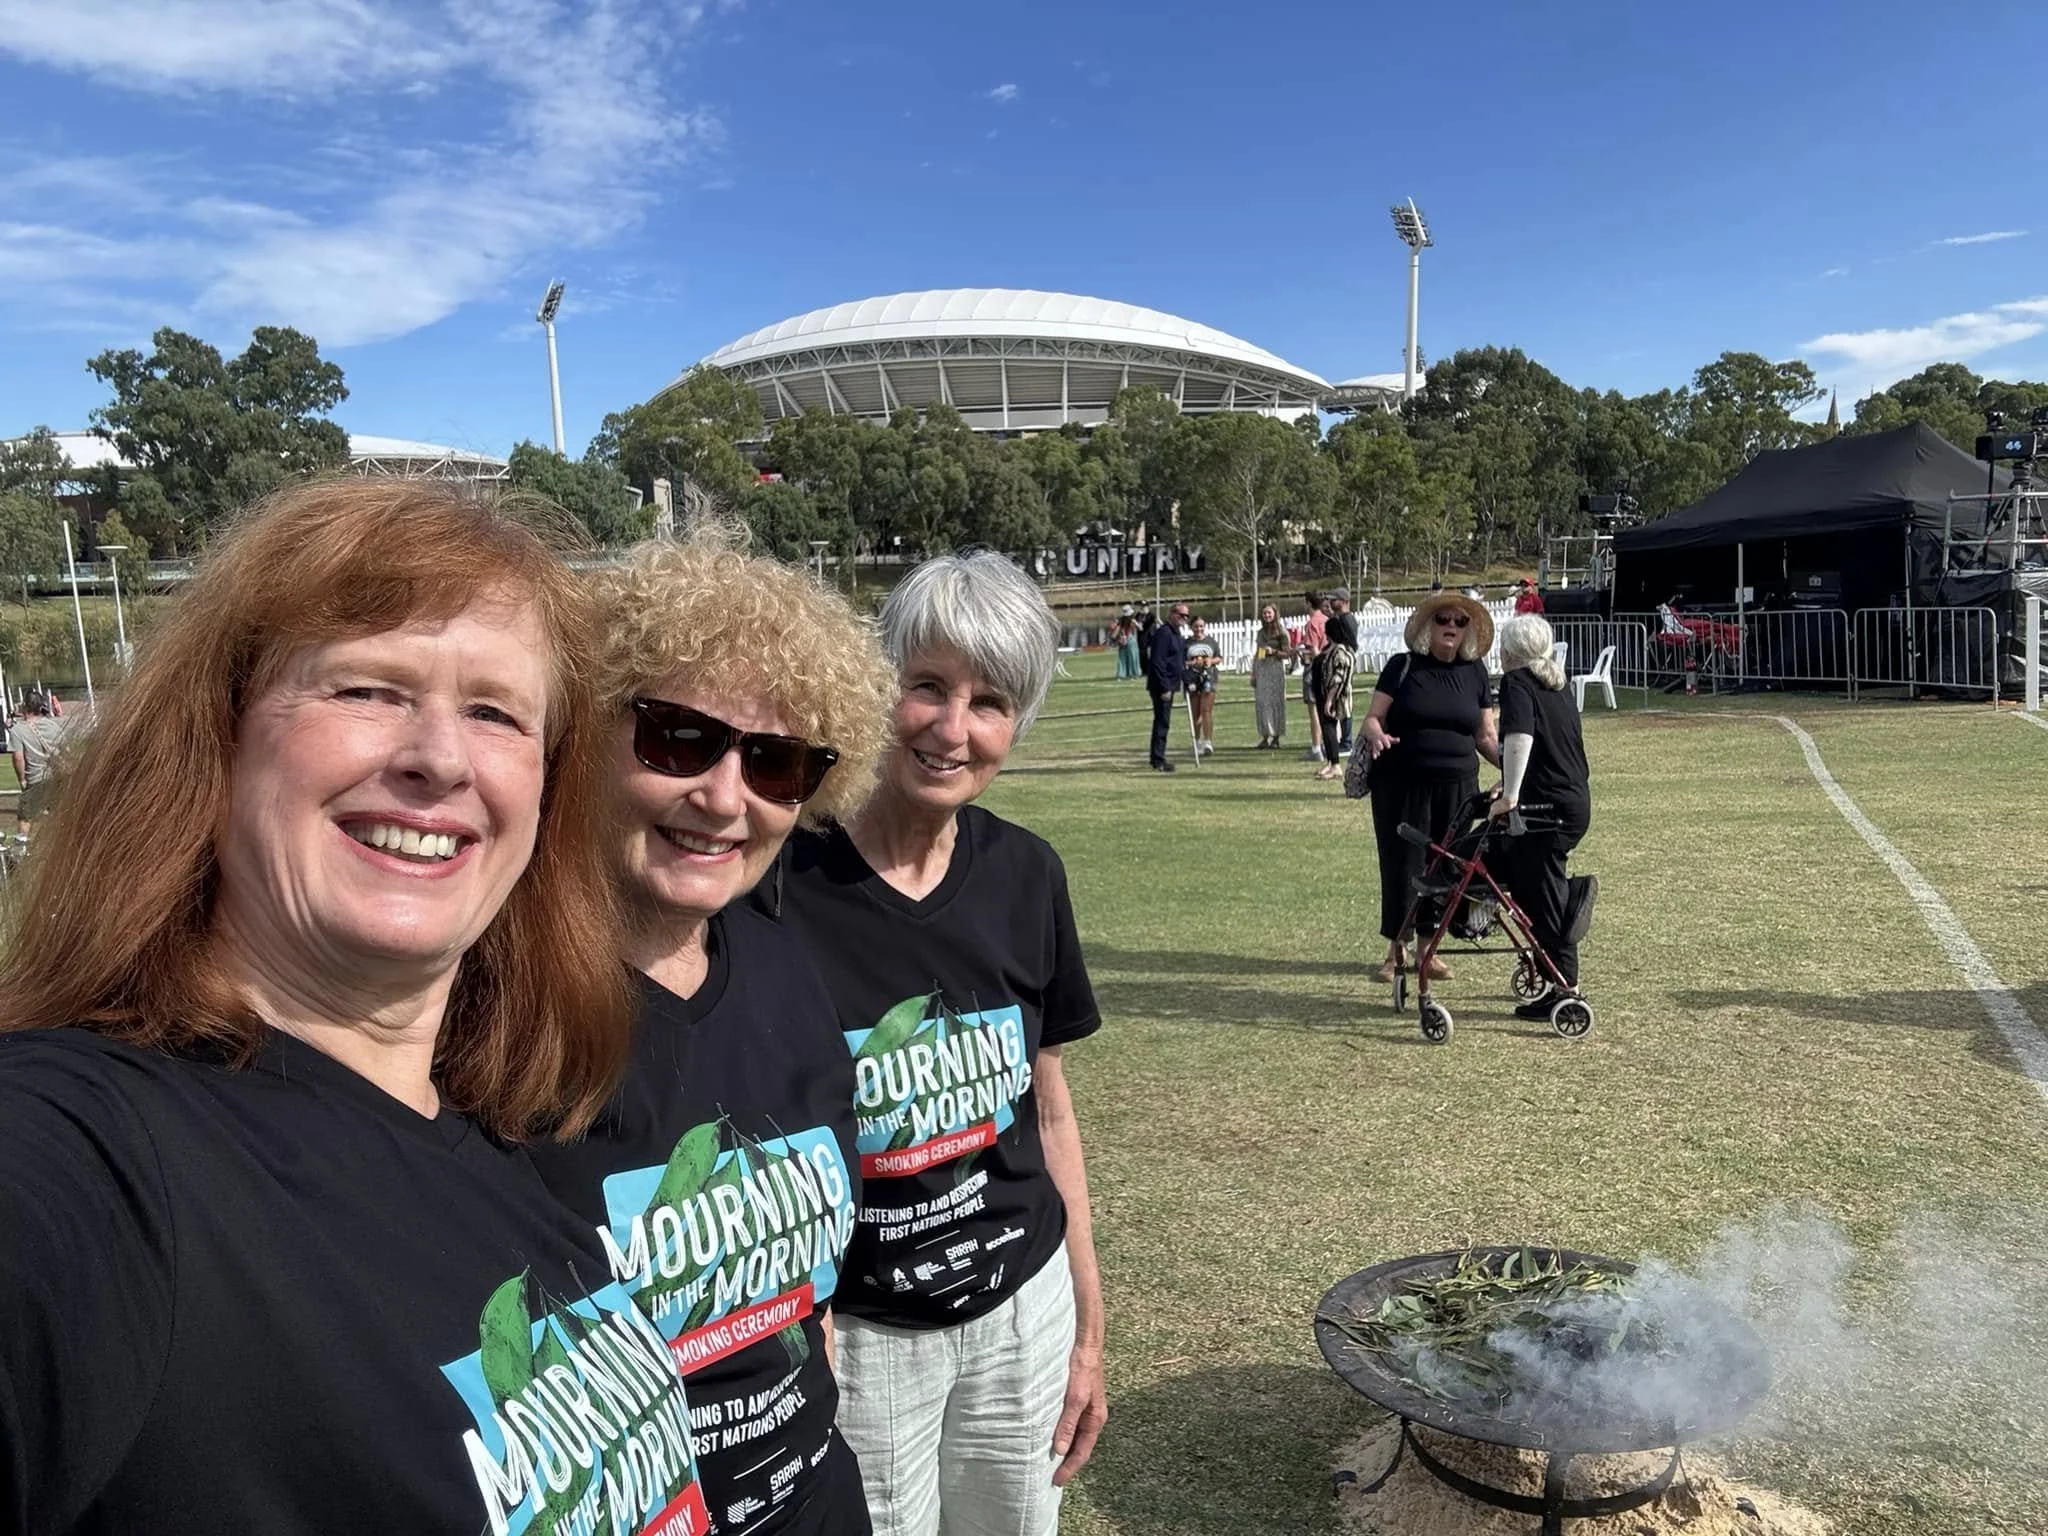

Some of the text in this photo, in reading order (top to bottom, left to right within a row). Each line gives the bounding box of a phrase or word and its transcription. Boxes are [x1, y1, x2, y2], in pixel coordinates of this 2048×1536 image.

[853, 1018, 1021, 1110] OURNING
[857, 1061, 1032, 1141] IN THE MORNING
[874, 1131, 987, 1173] SMOKING CEREMONY
[596, 1143, 844, 1288] MOURNING
[858, 1206, 914, 1224] LISTENING
[915, 1202, 928, 1216] TO
[929, 1195, 950, 1213] AND
[880, 1193, 986, 1242] FIRST NATIONS PEOPLE
[651, 1201, 856, 1321] IN THE MORNING
[945, 1238, 980, 1260] SARAH
[731, 1296, 801, 1342] CEREMONY
[725, 1398, 744, 1422] TO
[690, 1431, 720, 1457] RST
[722, 1411, 775, 1450] NATIONS
[770, 1455, 804, 1491] SARAH
